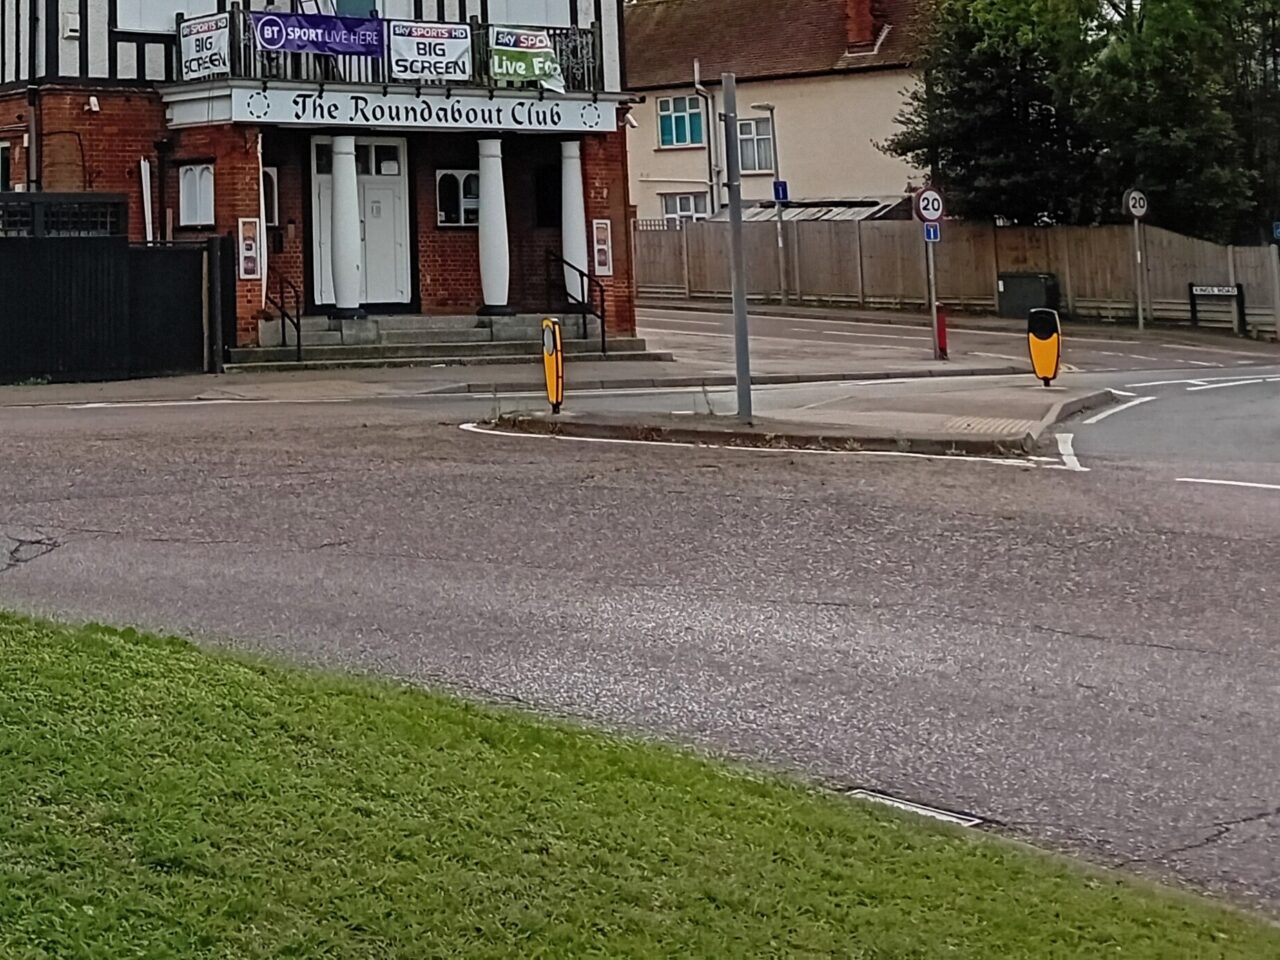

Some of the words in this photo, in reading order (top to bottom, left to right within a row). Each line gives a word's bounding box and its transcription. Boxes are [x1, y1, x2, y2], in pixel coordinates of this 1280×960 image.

[190, 20, 217, 34] SPORTS
[411, 27, 449, 38] SPORTS
[451, 28, 466, 38] HD
[264, 26, 280, 39] BT
[287, 27, 323, 41] SPORT
[325, 30, 348, 43] LIVE
[350, 31, 379, 45] HERE
[497, 32, 516, 46] sky
[195, 36, 213, 53] BIG
[416, 42, 446, 57] BIG
[184, 52, 228, 75] SCREEN
[395, 59, 467, 75] SCREEN
[493, 55, 526, 75] Live
[292, 93, 339, 122] The
[349, 95, 503, 126] Roundabout
[511, 102, 562, 127] Club
[922, 196, 940, 211] 20
[1131, 196, 1145, 209] 20
